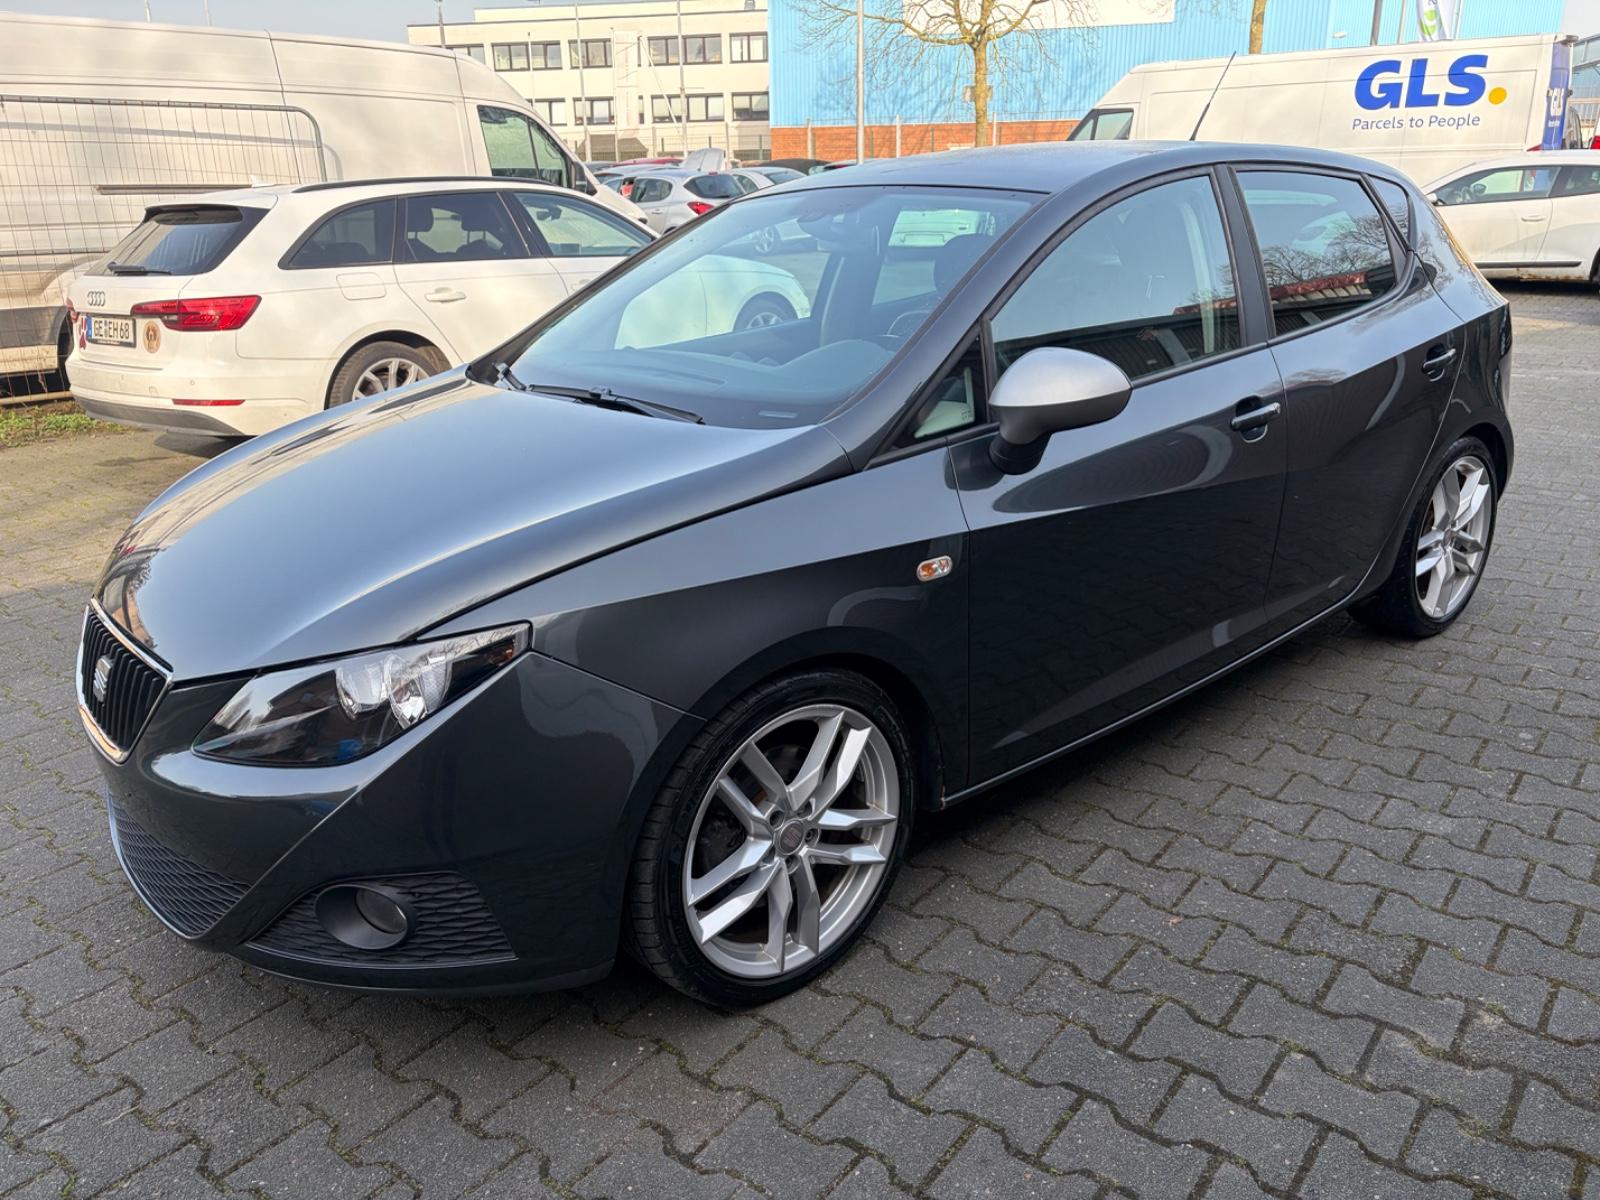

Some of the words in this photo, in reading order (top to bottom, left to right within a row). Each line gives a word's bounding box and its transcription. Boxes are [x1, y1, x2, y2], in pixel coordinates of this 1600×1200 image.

[1352, 117, 1404, 130] Parcels
[1409, 116, 1424, 129] to
[1428, 114, 1481, 130] People
[94, 320, 103, 337] GE
